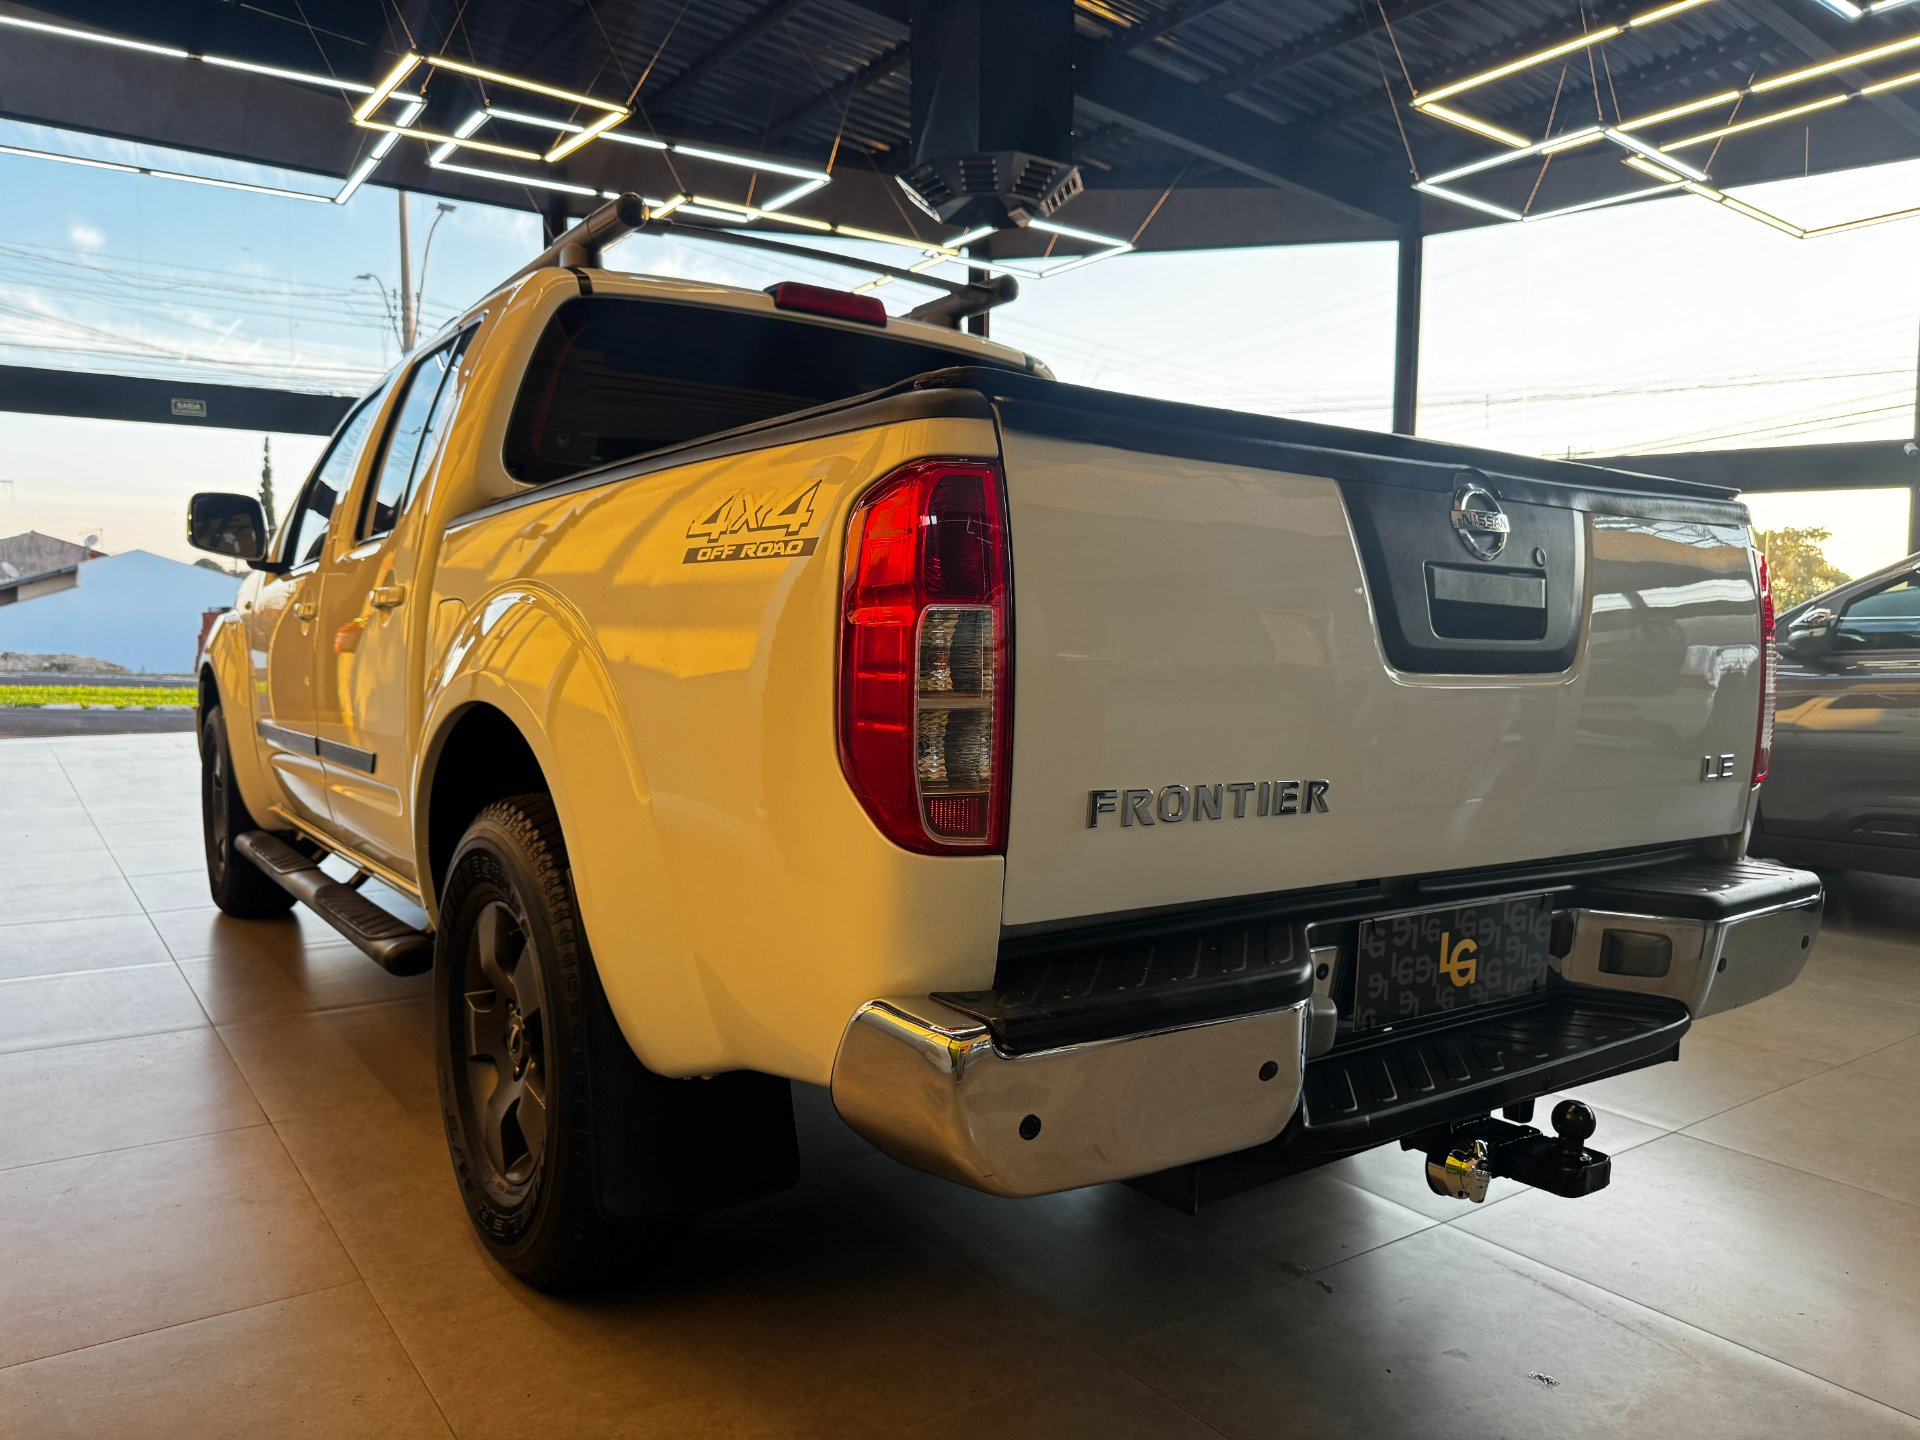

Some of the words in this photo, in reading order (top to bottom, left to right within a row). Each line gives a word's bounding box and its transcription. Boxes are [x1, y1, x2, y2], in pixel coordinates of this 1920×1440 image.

[1461, 512, 1508, 530] NISSAN
[696, 545, 737, 561] OFF
[739, 540, 804, 558] ROAD
[1700, 753, 1735, 782] LE
[1086, 778, 1330, 828] FRONTIER
[1439, 931, 1478, 988] LG
